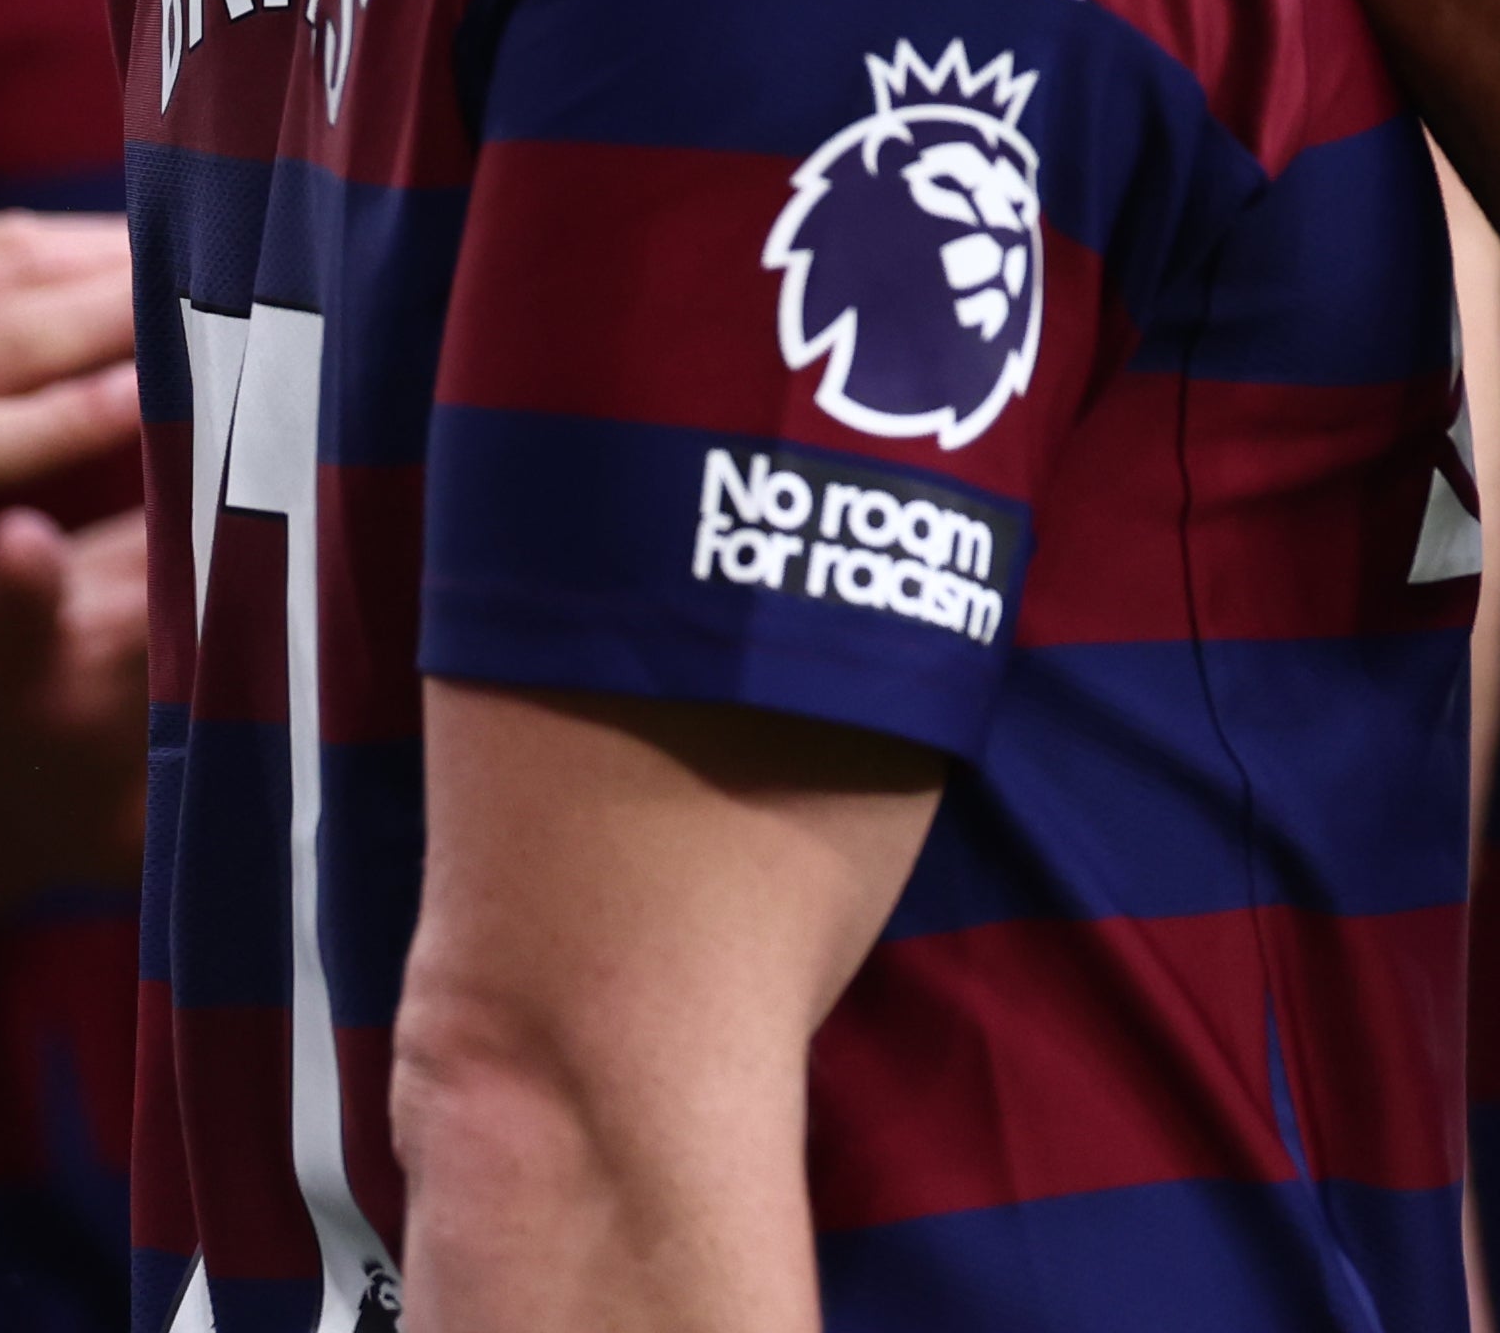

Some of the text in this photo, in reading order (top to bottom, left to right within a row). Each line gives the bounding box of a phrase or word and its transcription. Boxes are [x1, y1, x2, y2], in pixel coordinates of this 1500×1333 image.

[691, 511, 1004, 647] for racism
[699, 447, 994, 581] No room
